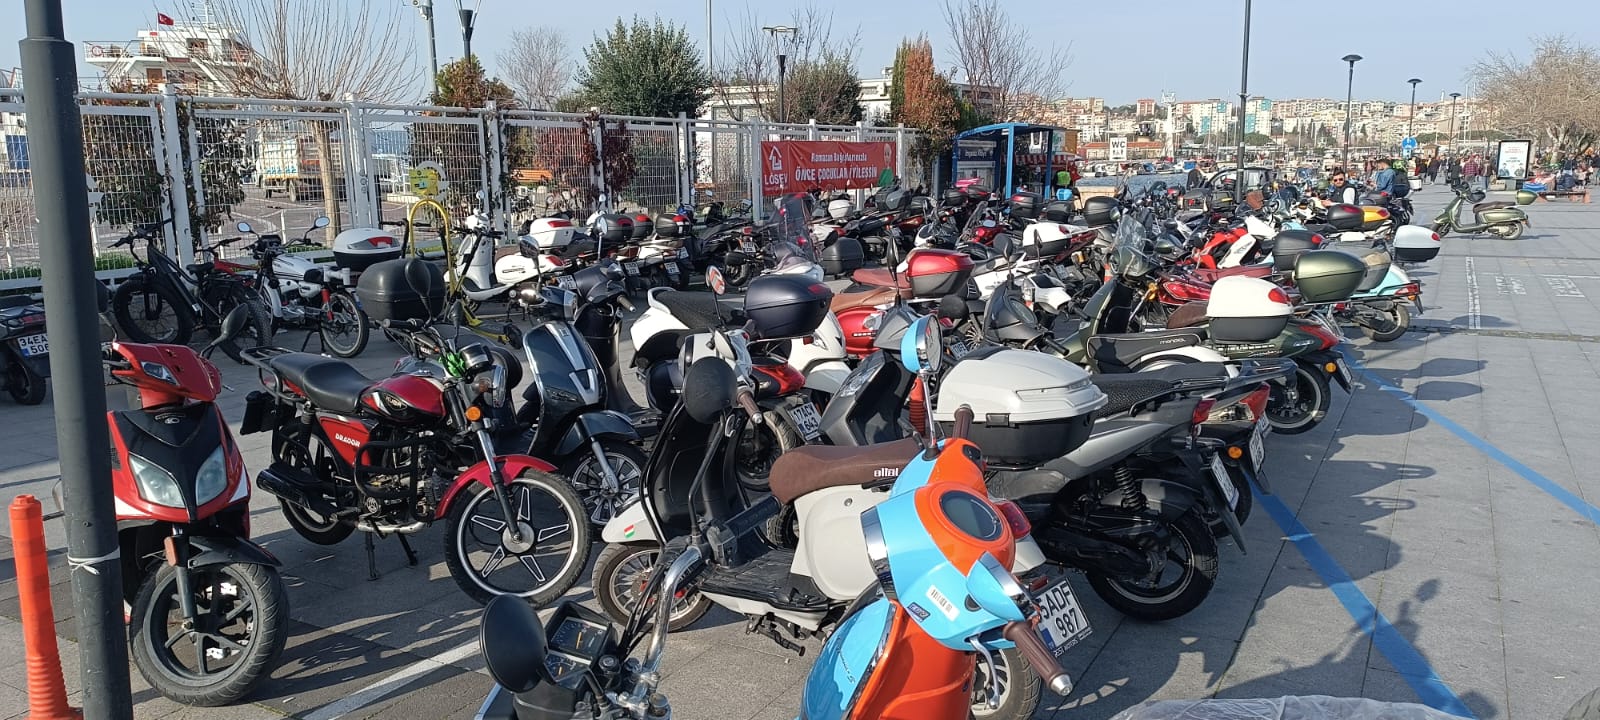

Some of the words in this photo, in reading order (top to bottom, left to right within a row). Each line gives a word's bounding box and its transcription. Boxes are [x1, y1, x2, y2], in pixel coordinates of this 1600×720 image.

[1111, 140, 1126, 148] WC
[795, 166, 815, 181] ÖNCE
[818, 167, 848, 183] ÇOCUKLAR
[1037, 582, 1071, 620] 5ADF
[1055, 607, 1079, 638] 987
